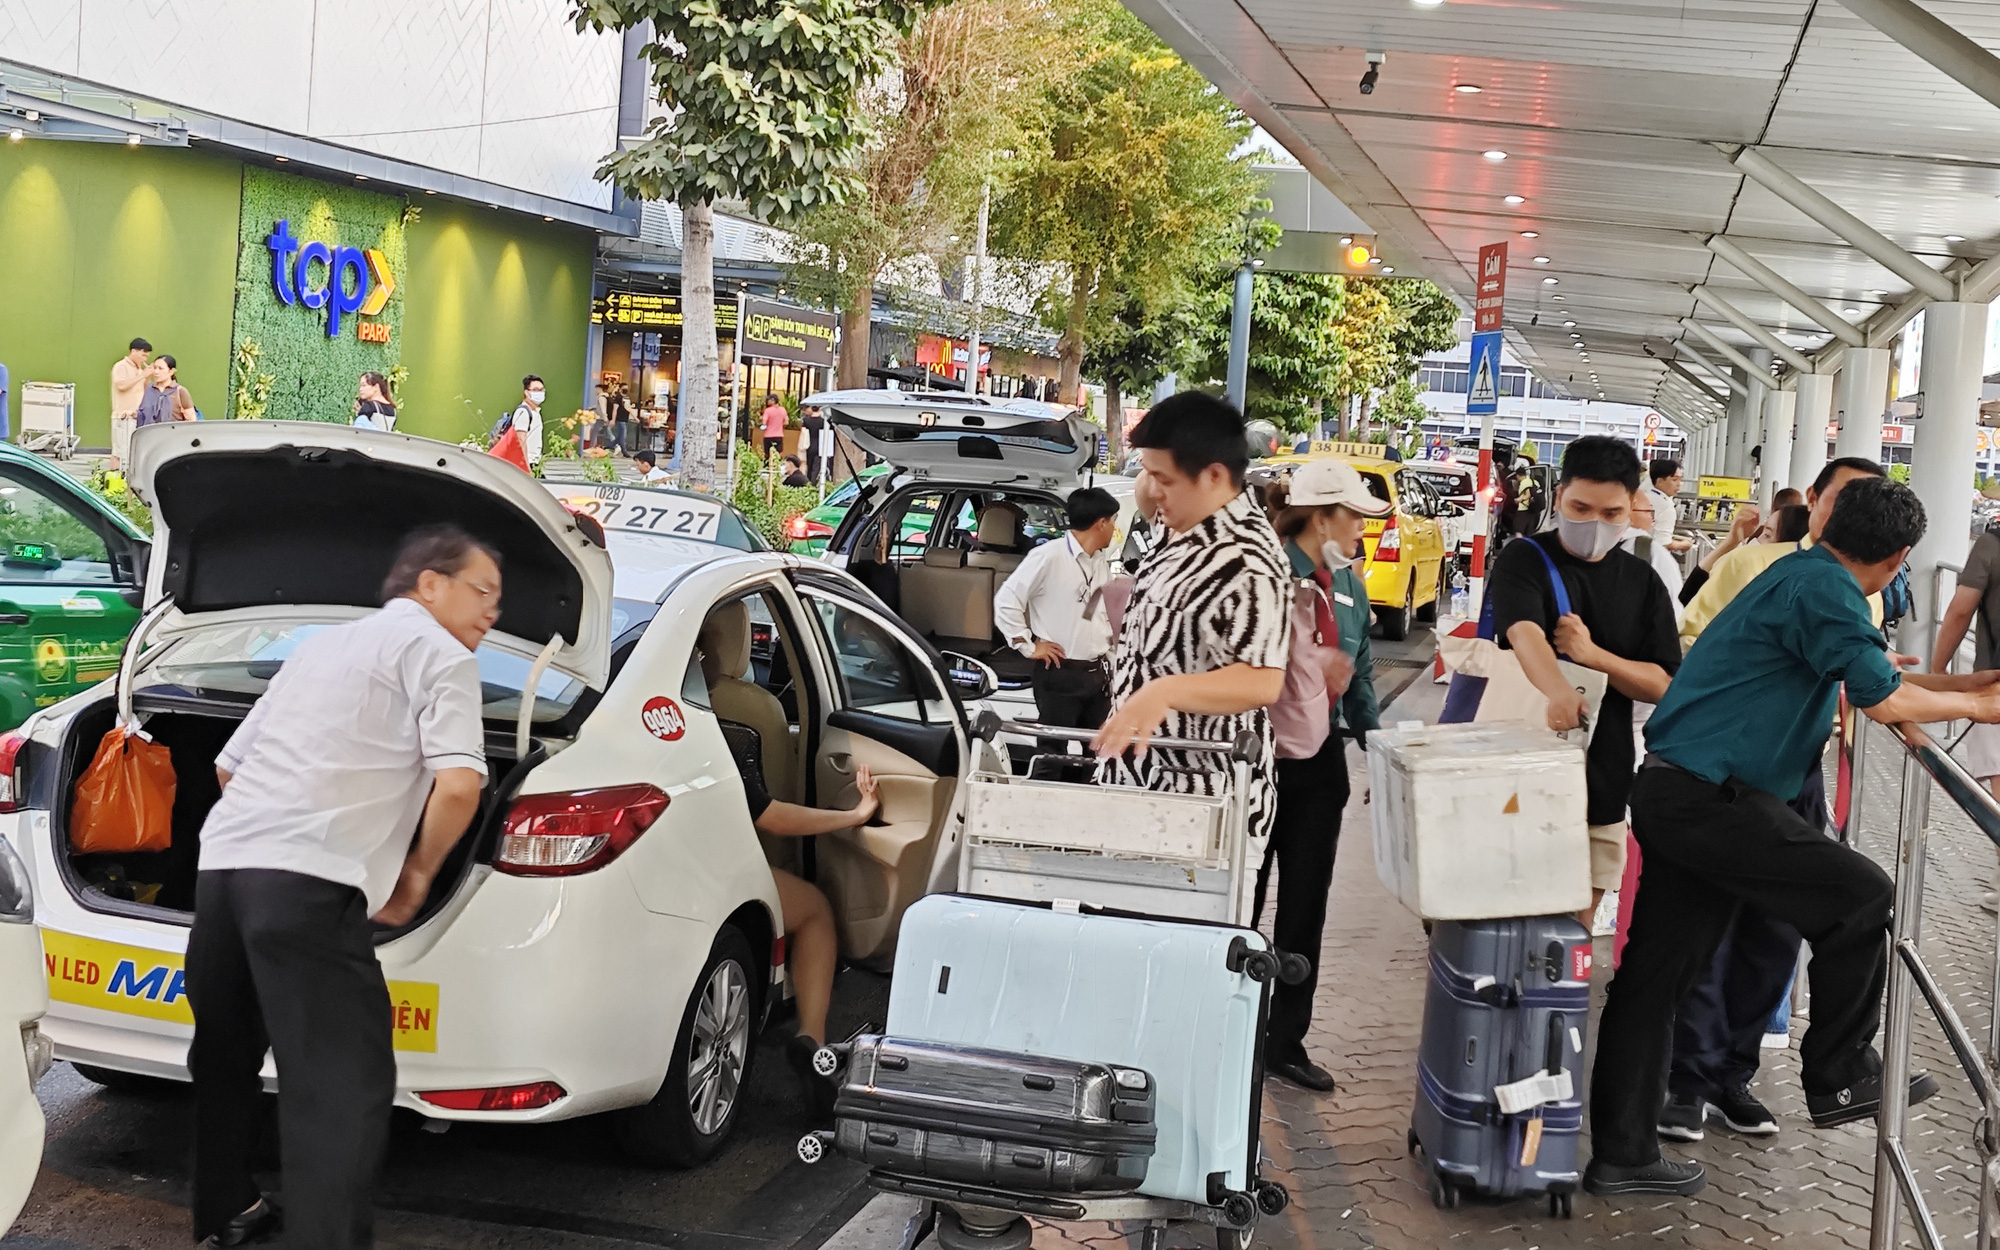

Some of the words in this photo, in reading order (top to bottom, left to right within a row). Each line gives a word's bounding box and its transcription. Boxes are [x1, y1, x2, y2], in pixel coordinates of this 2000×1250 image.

[268, 219, 368, 337] tcp
[358, 321, 391, 342] PARK
[1314, 442, 1332, 452] 38
[1360, 445, 1381, 455] 111
[594, 486, 626, 501] (028)
[625, 505, 668, 529] 27
[673, 510, 716, 535] 27
[643, 704, 686, 738] 9964
[62, 957, 100, 985] LED
